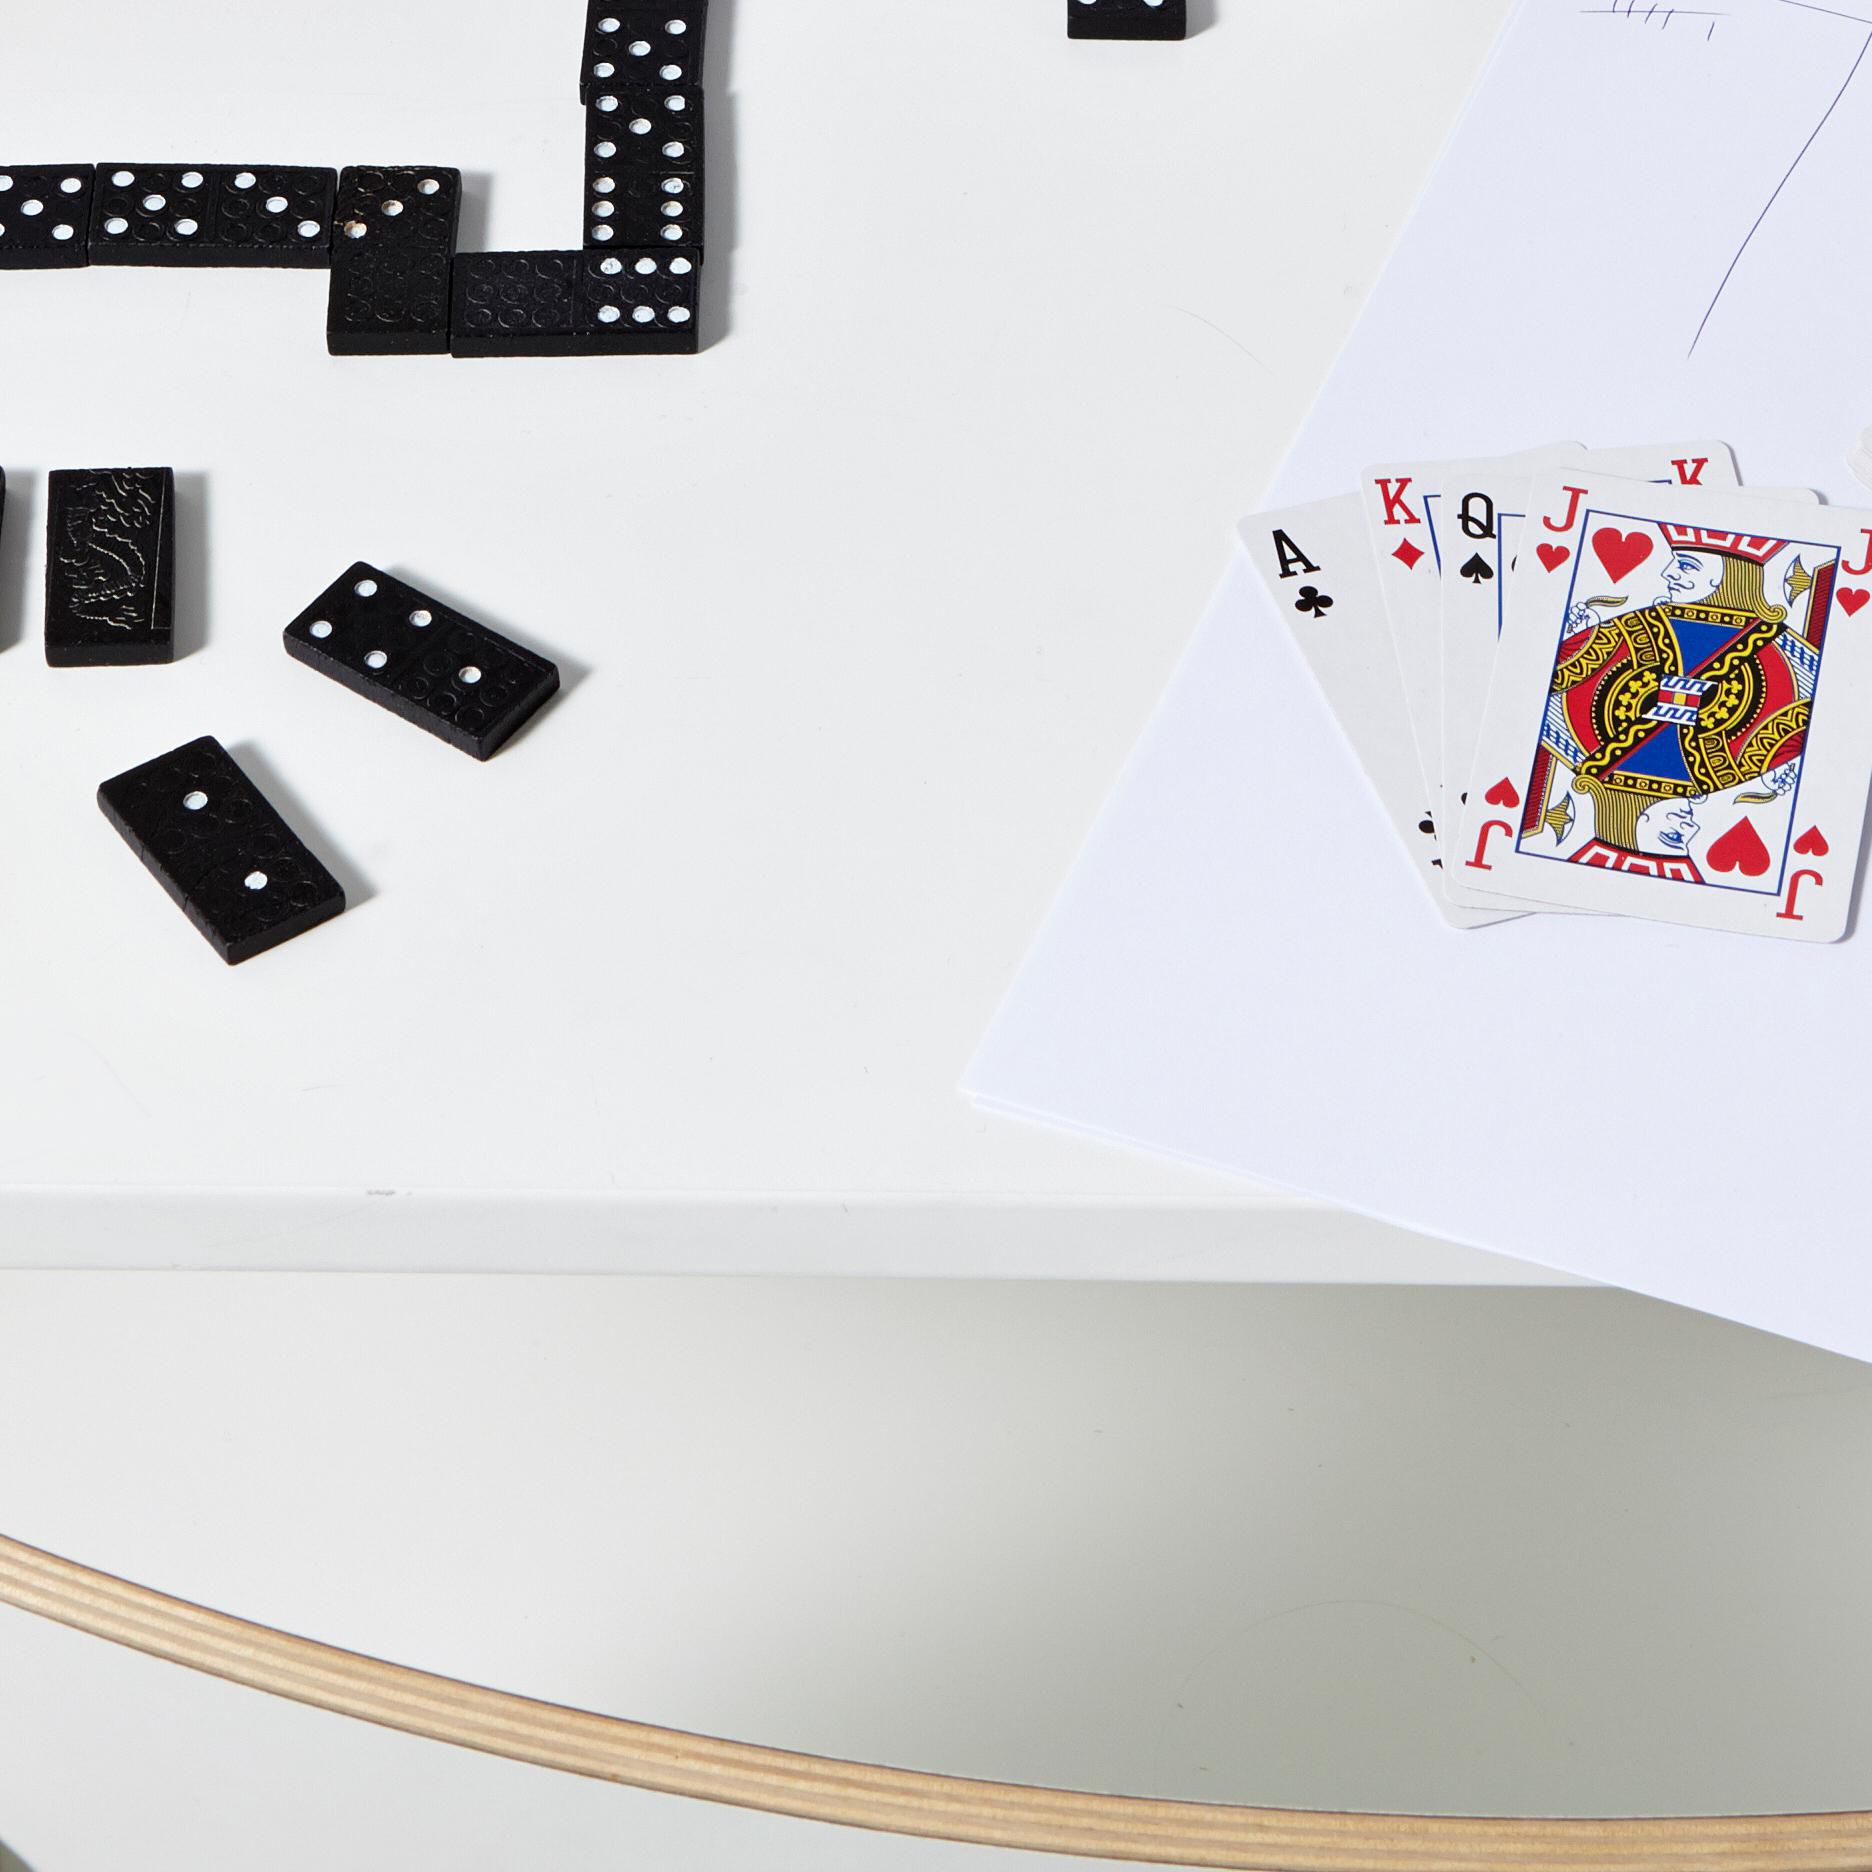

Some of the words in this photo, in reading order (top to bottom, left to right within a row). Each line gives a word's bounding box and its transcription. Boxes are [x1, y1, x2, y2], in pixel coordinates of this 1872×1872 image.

[1374, 477, 1421, 525] K
[1456, 492, 1497, 540] Q
[1542, 485, 1589, 532] J
[1271, 528, 1322, 579] A
[1465, 819, 1514, 871] J
[1776, 868, 1824, 920] J
